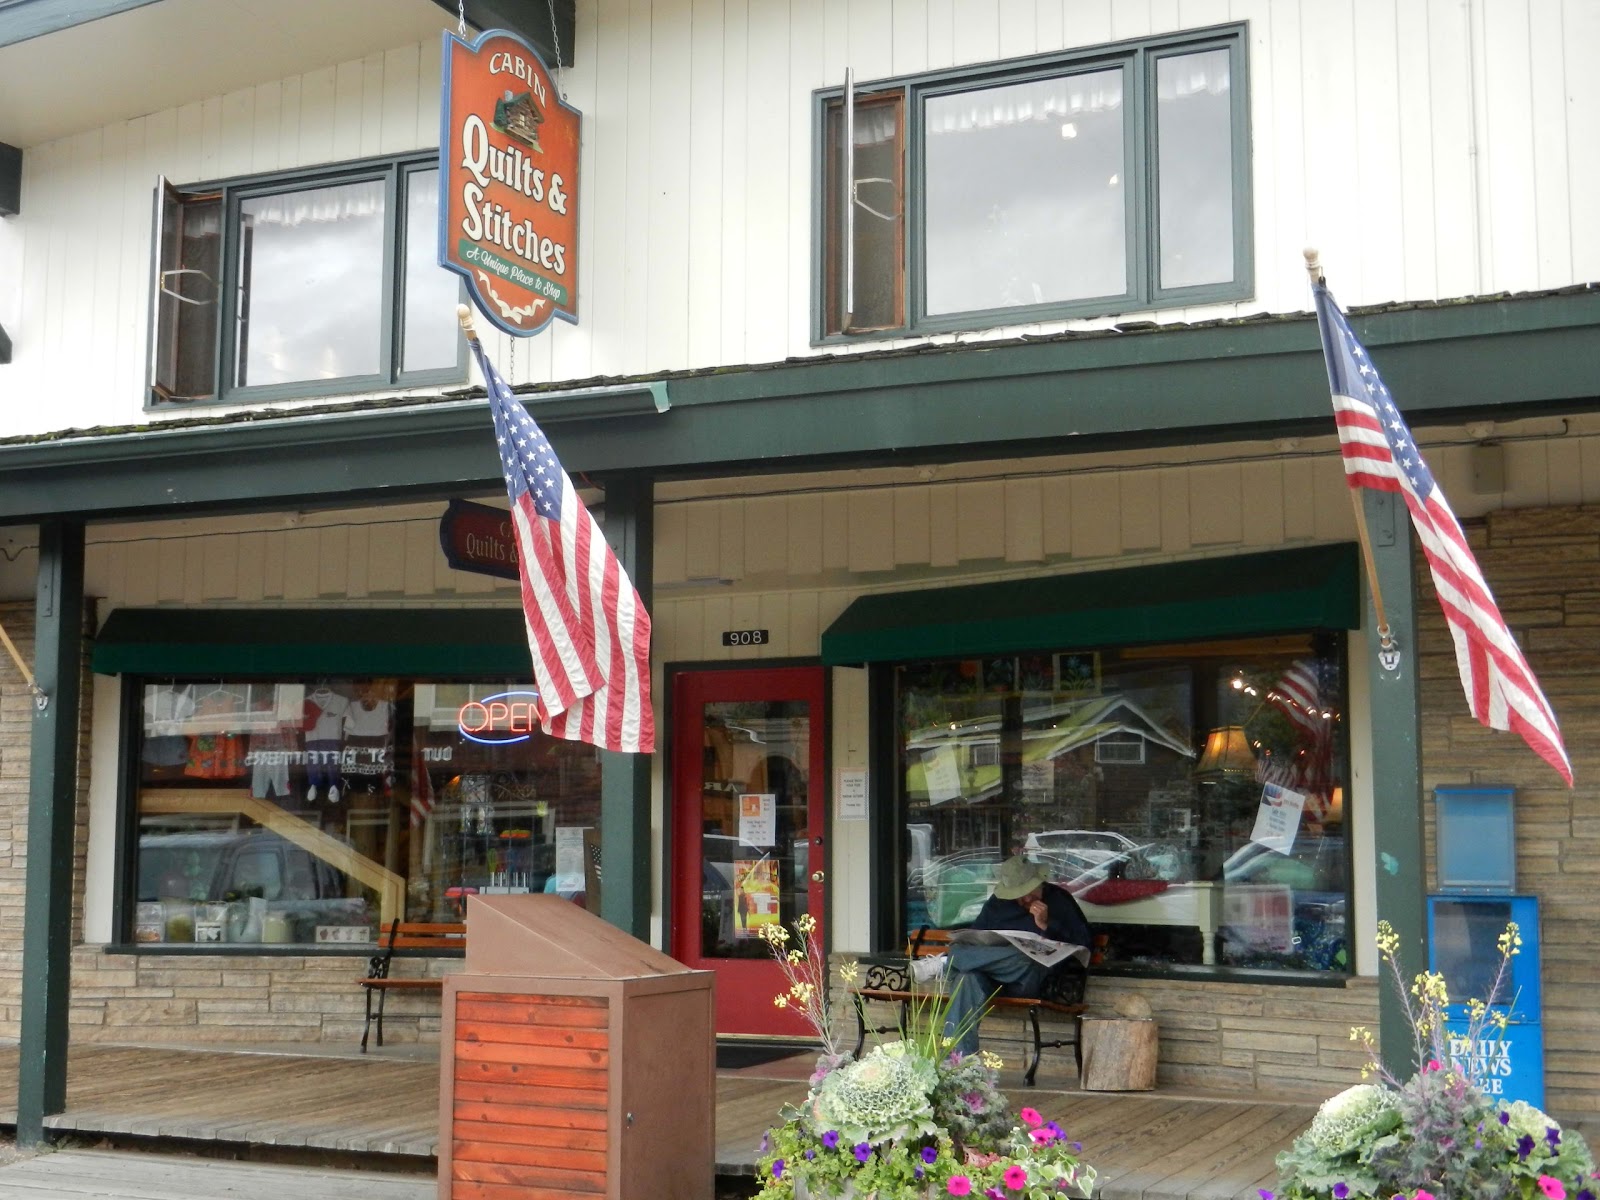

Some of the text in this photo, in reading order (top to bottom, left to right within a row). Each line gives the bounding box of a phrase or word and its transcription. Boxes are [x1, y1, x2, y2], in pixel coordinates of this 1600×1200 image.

[489, 52, 546, 108] CABIN
[461, 113, 567, 215] Quilts &
[461, 181, 566, 275] Stitches
[466, 247, 561, 301] A Unique Place to Shop
[466, 532, 505, 562] Quilts
[730, 630, 762, 646] 908
[459, 701, 543, 732] OPEN
